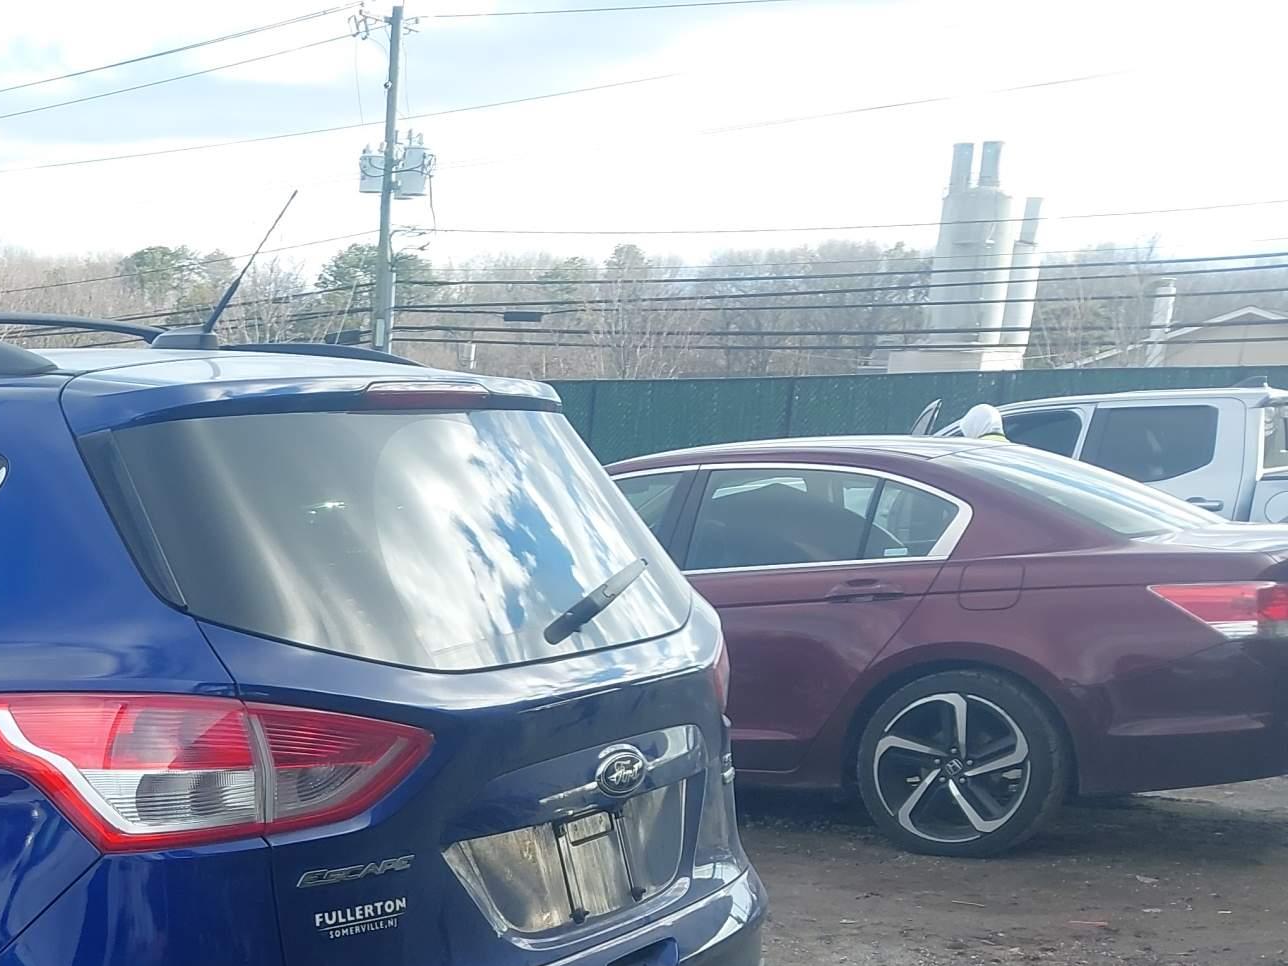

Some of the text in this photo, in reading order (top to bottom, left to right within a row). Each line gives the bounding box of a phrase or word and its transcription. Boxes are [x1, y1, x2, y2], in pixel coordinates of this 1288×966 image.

[608, 760, 643, 785] Ford
[296, 854, 415, 888] ESCAPE
[315, 897, 407, 927] FULLERTON
